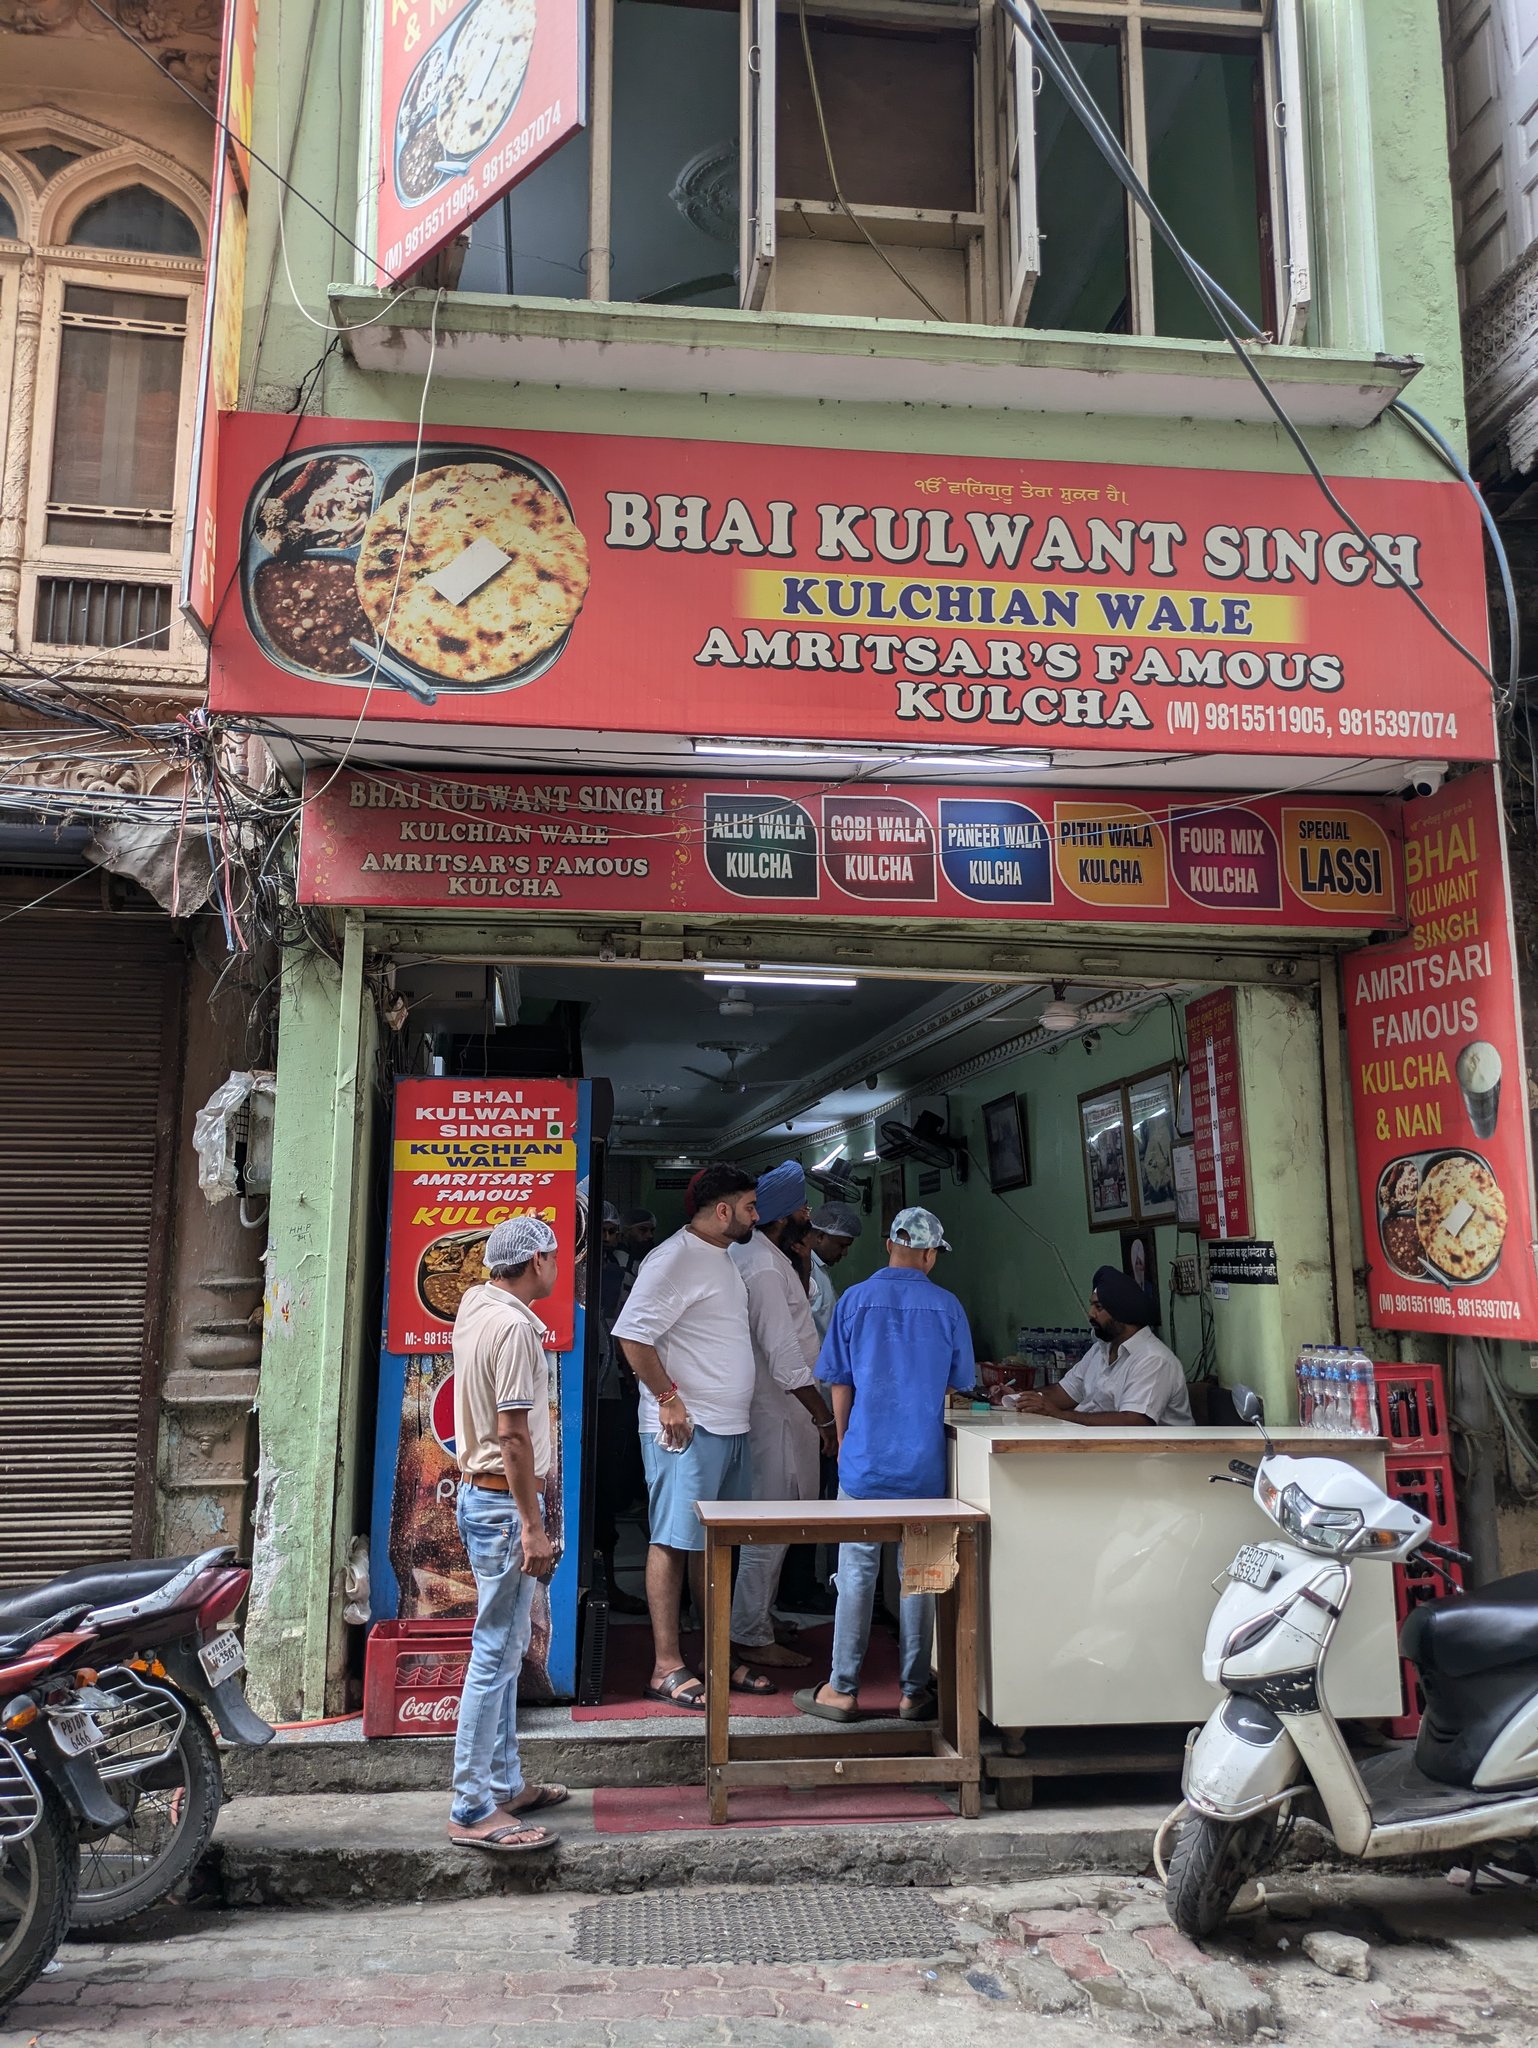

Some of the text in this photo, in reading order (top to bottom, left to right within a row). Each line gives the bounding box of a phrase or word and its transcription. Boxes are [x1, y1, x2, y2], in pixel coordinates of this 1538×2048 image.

[384, 99, 562, 279] (M) 9815511905, 9815397074
[948, 478, 1014, 504] ਵਾਹਿਗੁਰੂ
[1020, 481, 1053, 499] ਤੇਰਾ
[606, 491, 1423, 588] BHAI KULWANT SINGH
[782, 577, 1253, 636] KULCHIAN WALE
[694, 627, 1344, 693] AMRITSAR'S FAMOUS
[895, 681, 1152, 730] KULCHA
[1167, 700, 1457, 739] (M) 9815511905, 9815397074
[350, 781, 664, 815] BHAI KULWANT SINGH
[400, 822, 609, 845] KULCHIAN WALE
[712, 813, 806, 840] ALLU WALA
[831, 815, 926, 843] GOBI WALA
[948, 823, 1042, 849] PANEER WALA
[1061, 821, 1153, 848] PITHI WALA
[1299, 819, 1350, 842] SPECIAL
[1179, 827, 1265, 856] FOUR MIX
[1405, 817, 1477, 885] BHAI
[360, 853, 648, 877] AMRITSAR'S FAMOUS
[726, 853, 793, 879] KULCHA
[845, 855, 914, 882] KULCHA
[969, 860, 1022, 886] KULCHA
[1078, 859, 1143, 885] KULCHA
[1299, 846, 1384, 896] LASSI
[448, 876, 562, 897] KULCHA
[1190, 866, 1259, 894] KULCHA
[1407, 869, 1478, 918] KULWANT
[1413, 908, 1479, 951] SINGH
[1355, 941, 1492, 1006] AMRITSARI
[1372, 996, 1478, 1048] FAMOUS
[1361, 1051, 1451, 1095] KULCHA
[452, 1091, 523, 1104] BHAI
[415, 1107, 560, 1121] KULWANT
[1376, 1102, 1442, 1140] & NAN
[439, 1124, 534, 1137] SINGH
[410, 1143, 563, 1155] KULCHIAN
[446, 1156, 527, 1168] WALE
[413, 1173, 554, 1186] AMRITSAR'S
[436, 1189, 532, 1202] FAMOUS
[1379, 1293, 1521, 1320] (M) 9815511905, 9815397074
[405, 1331, 421, 1345] M:-
[399, 1696, 461, 1722] Coca-Col
